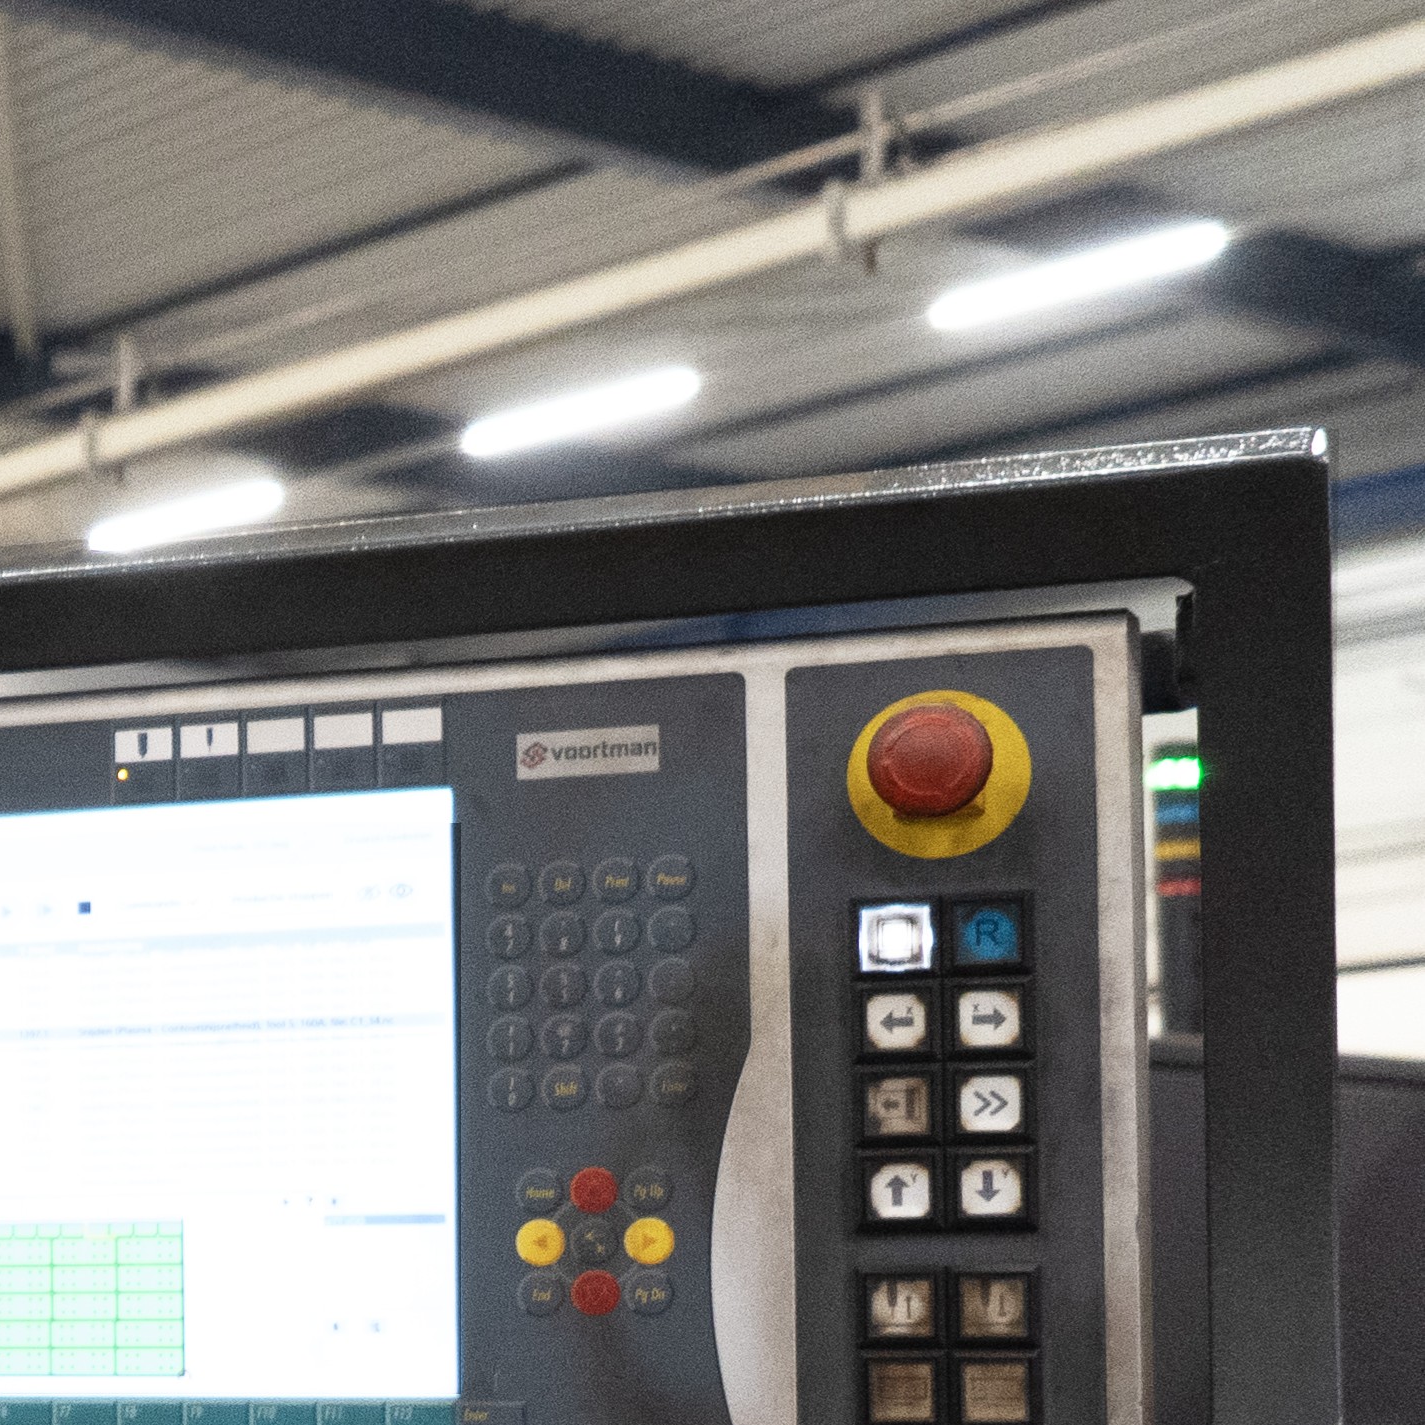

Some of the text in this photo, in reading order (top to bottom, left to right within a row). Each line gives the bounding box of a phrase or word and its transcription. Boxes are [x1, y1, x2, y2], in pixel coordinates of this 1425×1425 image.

[551, 741, 657, 762] voortman
[975, 918, 998, 946] R
[525, 1185, 556, 1200] Home
